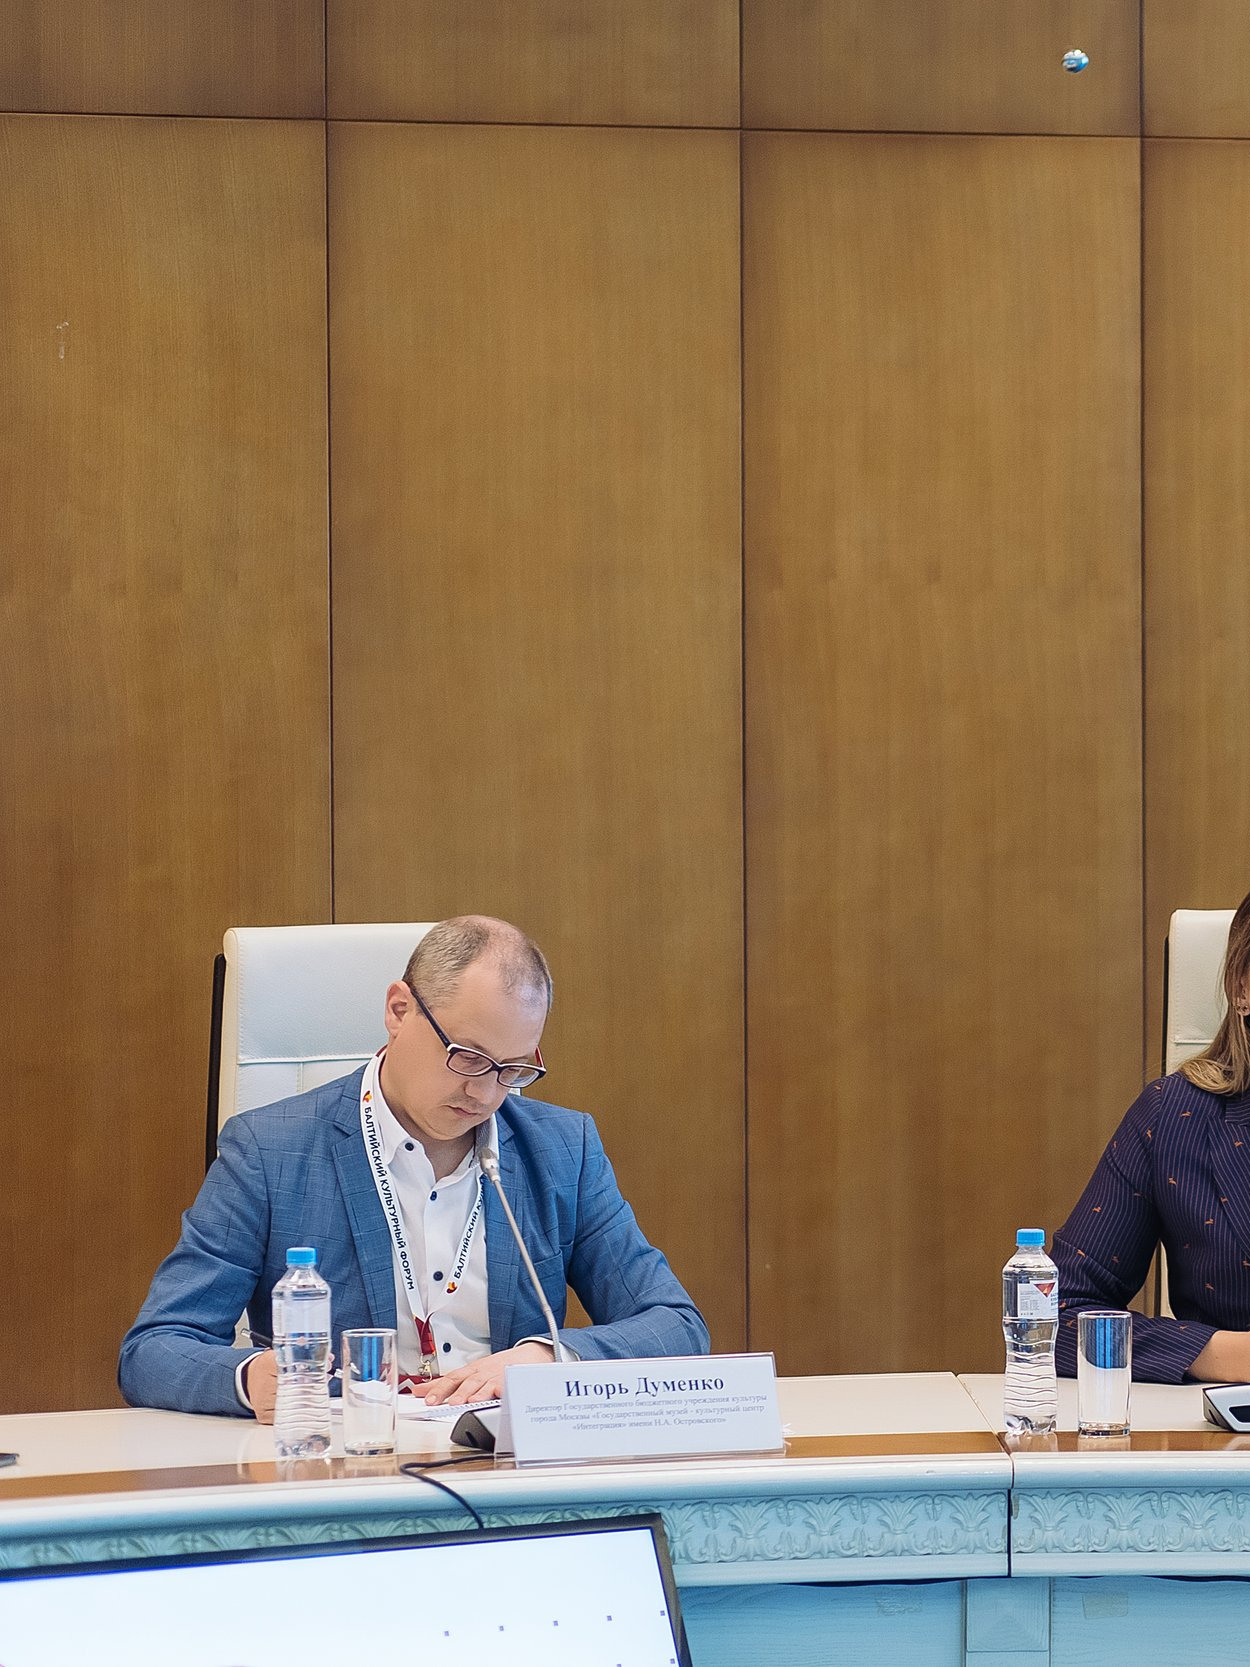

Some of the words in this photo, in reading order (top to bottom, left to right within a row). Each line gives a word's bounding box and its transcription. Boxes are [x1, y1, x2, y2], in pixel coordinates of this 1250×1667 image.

[365, 1107, 387, 1177] БАЛТИЙСКИЙ
[380, 1179, 406, 1249] КУЛЬТУРНЫЙ
[400, 1251, 415, 1290] ФОРУМ
[454, 1211, 478, 1279] БАЛТИЙСКИЙ
[565, 1380, 629, 1400] Игорь
[635, 1377, 724, 1398] Думенко
[525, 1404, 562, 1413] Директор
[731, 1394, 767, 1404] культуры
[742, 1404, 765, 1413] центр
